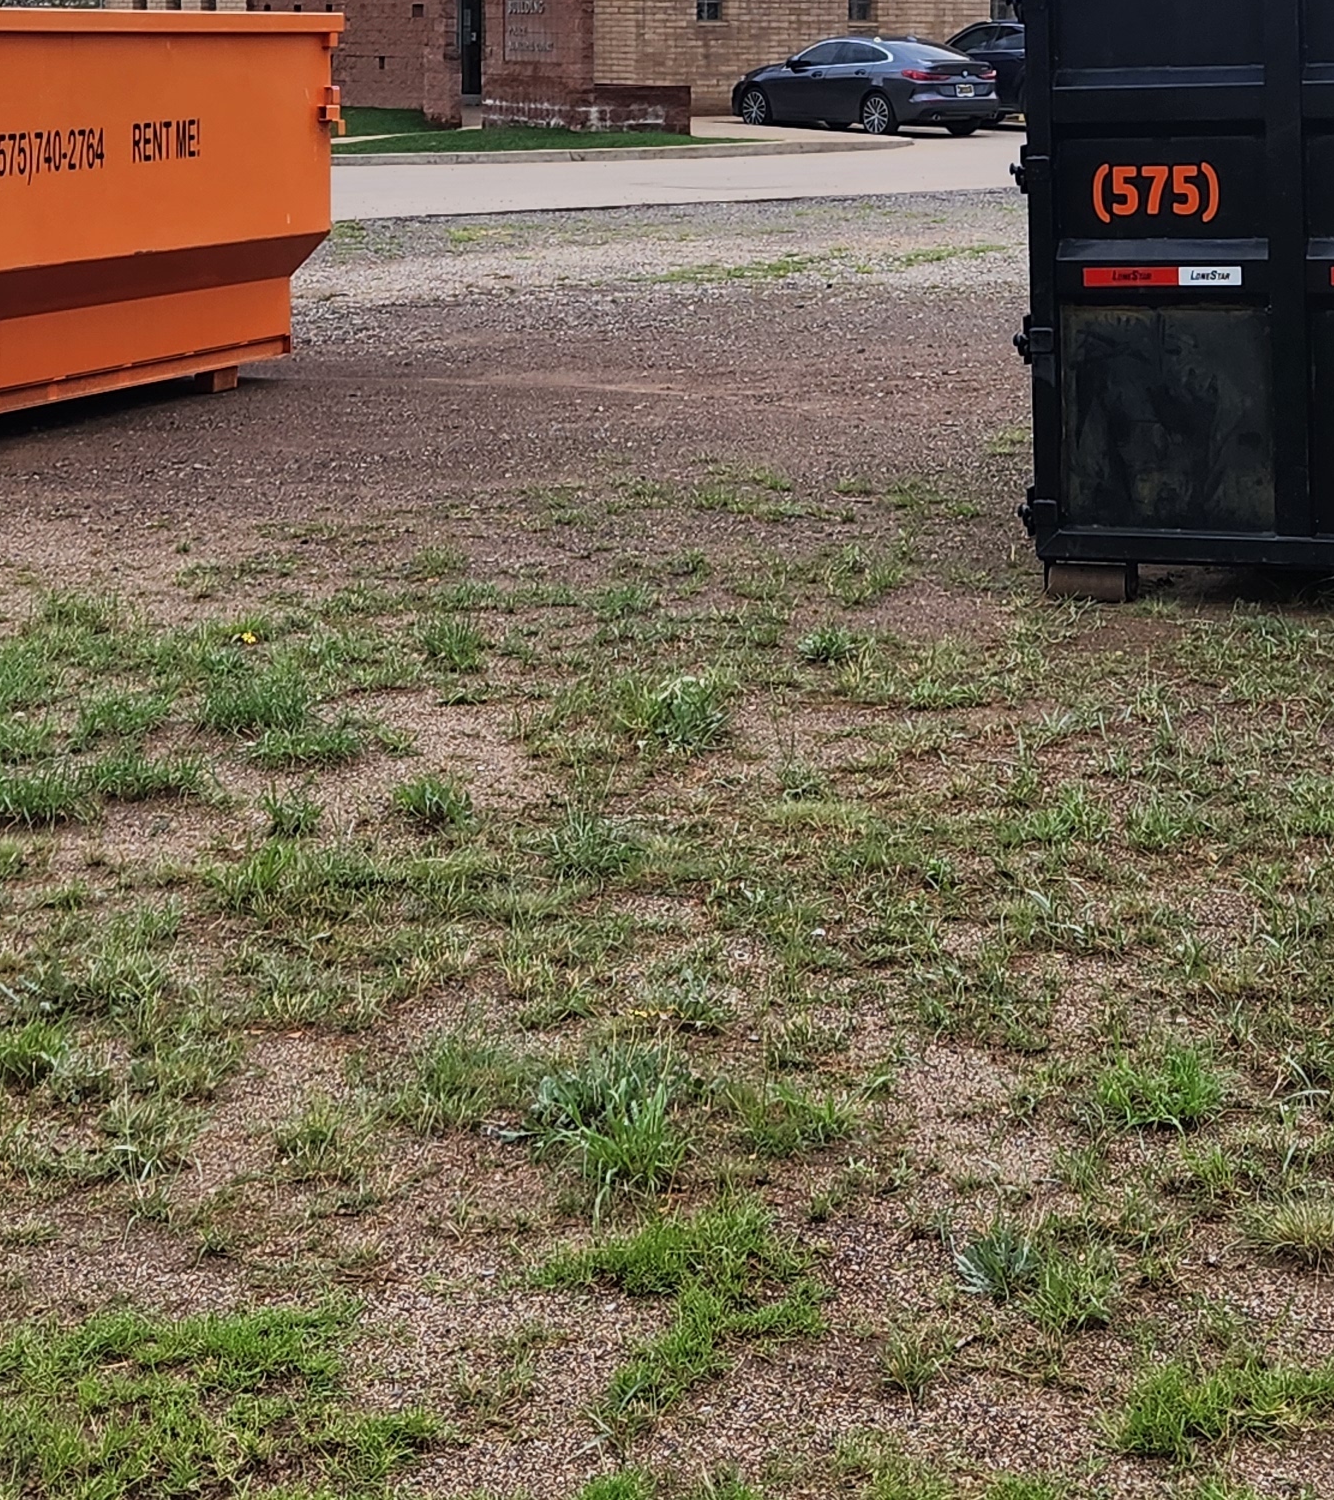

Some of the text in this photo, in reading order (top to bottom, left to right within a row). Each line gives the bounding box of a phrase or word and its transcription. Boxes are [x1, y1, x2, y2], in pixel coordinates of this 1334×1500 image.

[507, 0, 545, 14] BUILDING
[132, 121, 172, 164] RENT
[175, 118, 200, 159] ME!
[1092, 161, 1220, 224] (575)
